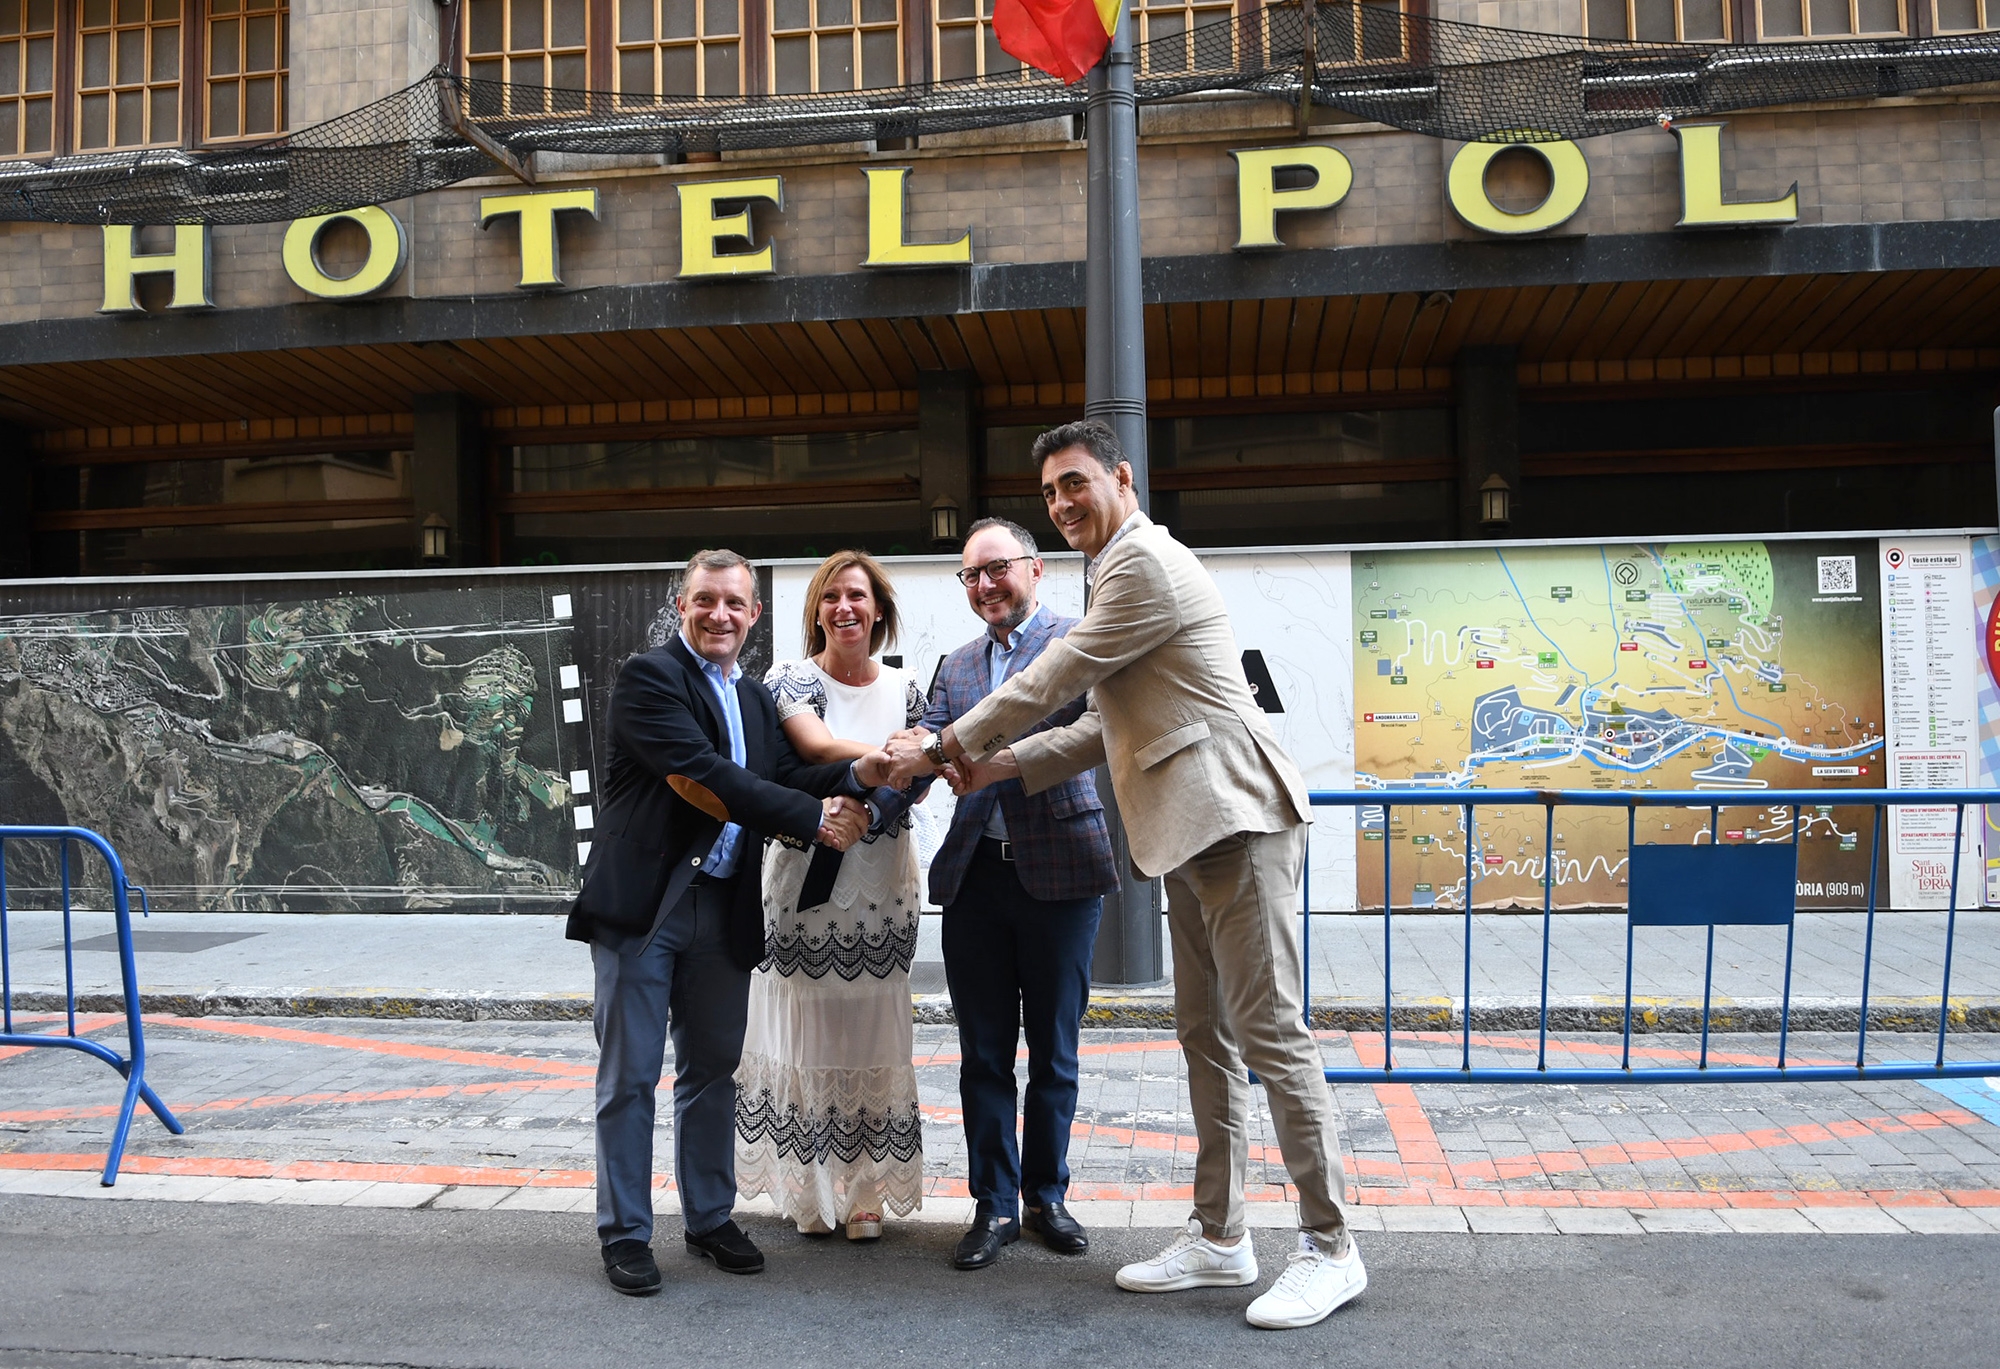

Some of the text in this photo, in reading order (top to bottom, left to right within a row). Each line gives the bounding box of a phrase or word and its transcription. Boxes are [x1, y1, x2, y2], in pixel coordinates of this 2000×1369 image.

[97, 121, 1800, 316] HOTEL POL
[1944, 555, 1957, 563] aquí
[1912, 859, 1930, 872] Sant
[1796, 880, 1865, 898] ÒRIA (909 m)
